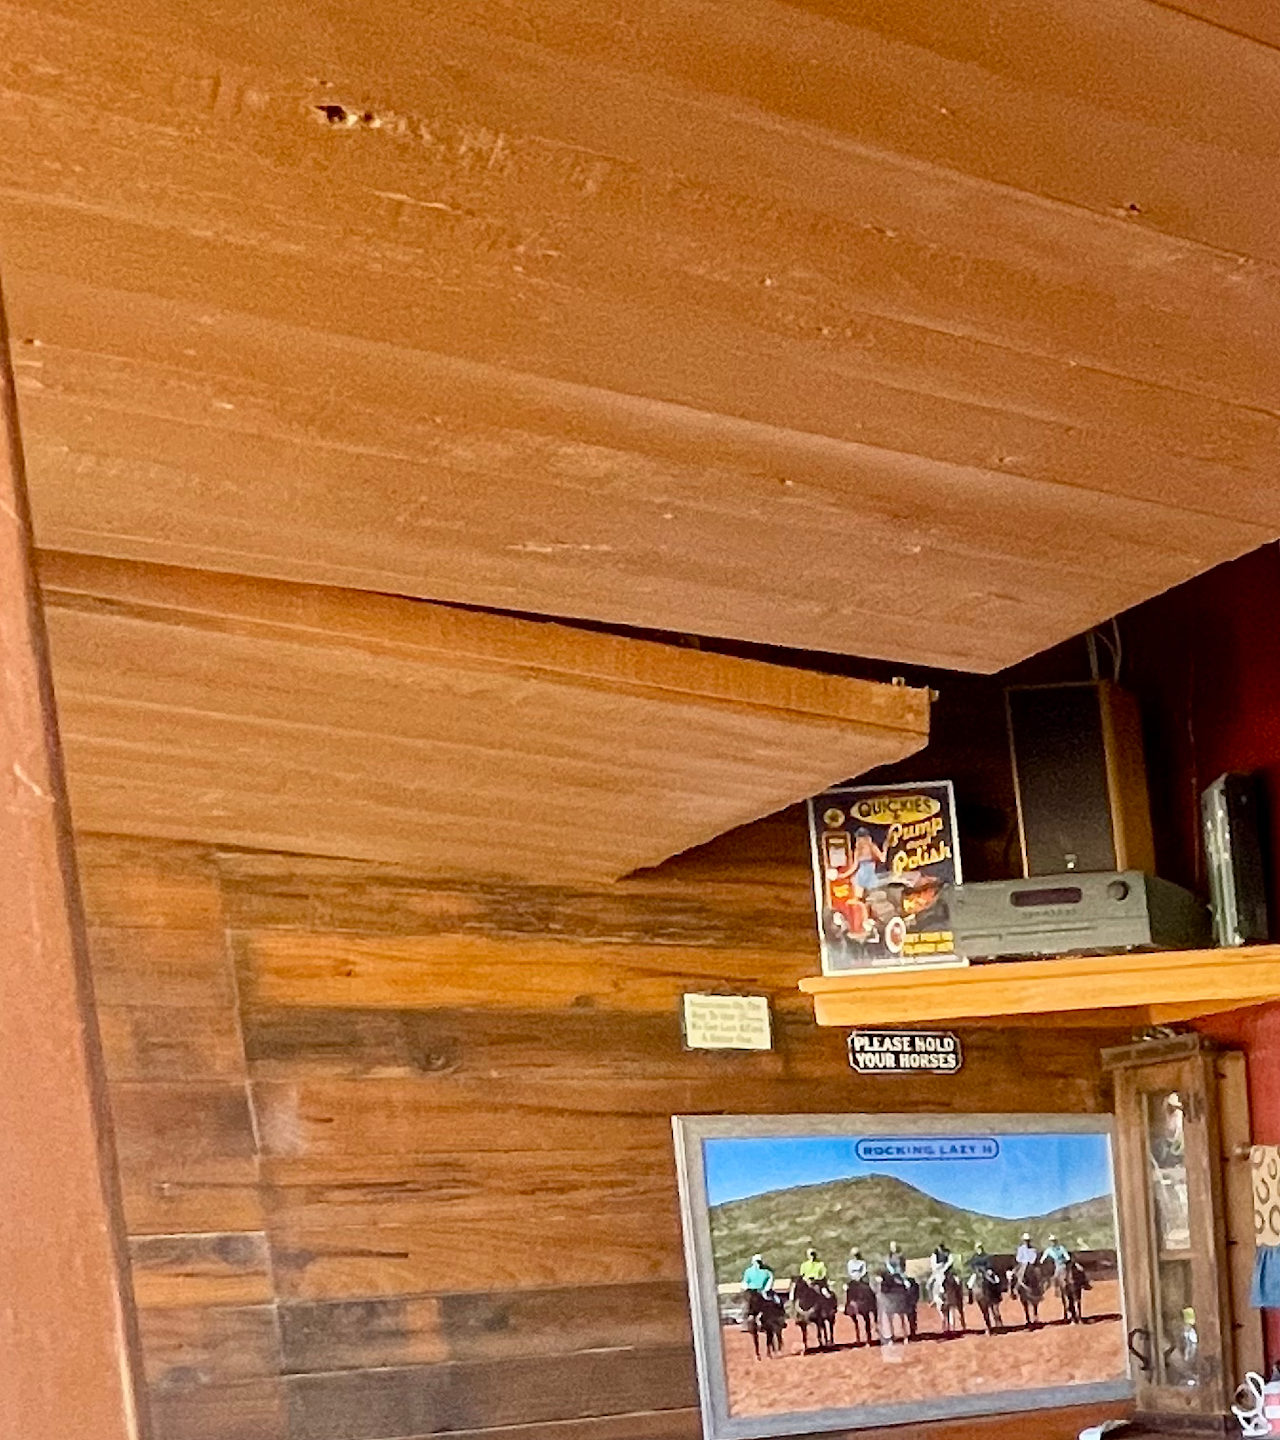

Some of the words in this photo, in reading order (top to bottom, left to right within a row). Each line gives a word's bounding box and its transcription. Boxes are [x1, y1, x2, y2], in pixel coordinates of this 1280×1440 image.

[858, 798, 933, 817] QUICKIES
[888, 817, 944, 847] Pump
[893, 841, 951, 876] Polish
[854, 1036, 912, 1051] PLEASE
[915, 1037, 954, 1052] HOLD
[855, 1052, 896, 1068] YOUR
[900, 1053, 956, 1069] HORSES
[863, 1146, 935, 1155] ROCKING
[940, 1145, 976, 1155] LAZY
